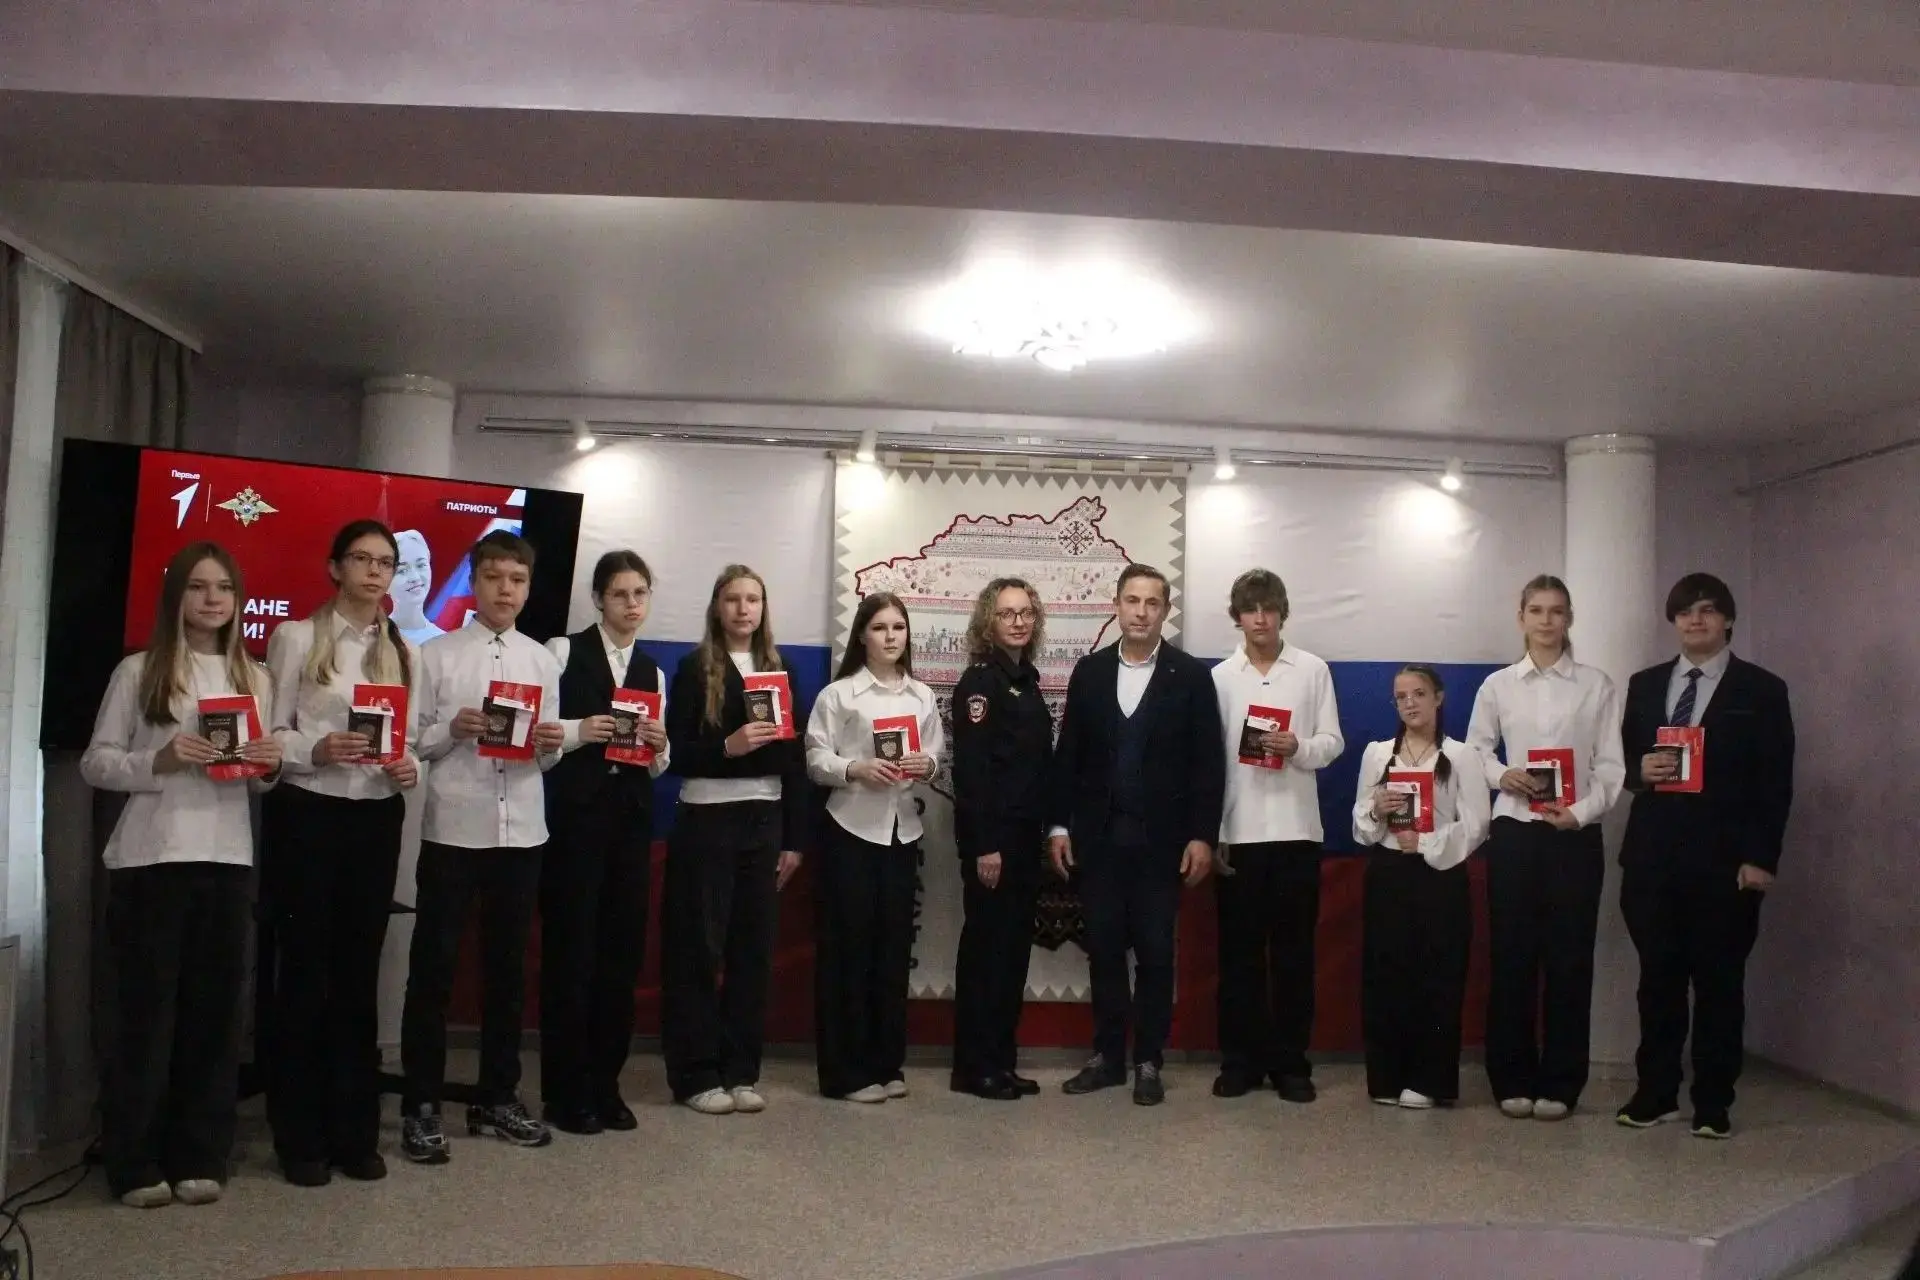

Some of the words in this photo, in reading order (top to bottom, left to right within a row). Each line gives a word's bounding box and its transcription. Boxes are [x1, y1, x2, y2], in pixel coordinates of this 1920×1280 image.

[171, 469, 200, 480] Первые
[446, 502, 498, 514] ПАТРИОТЫ
[243, 598, 290, 617] АНЕ
[243, 622, 265, 639] И!
